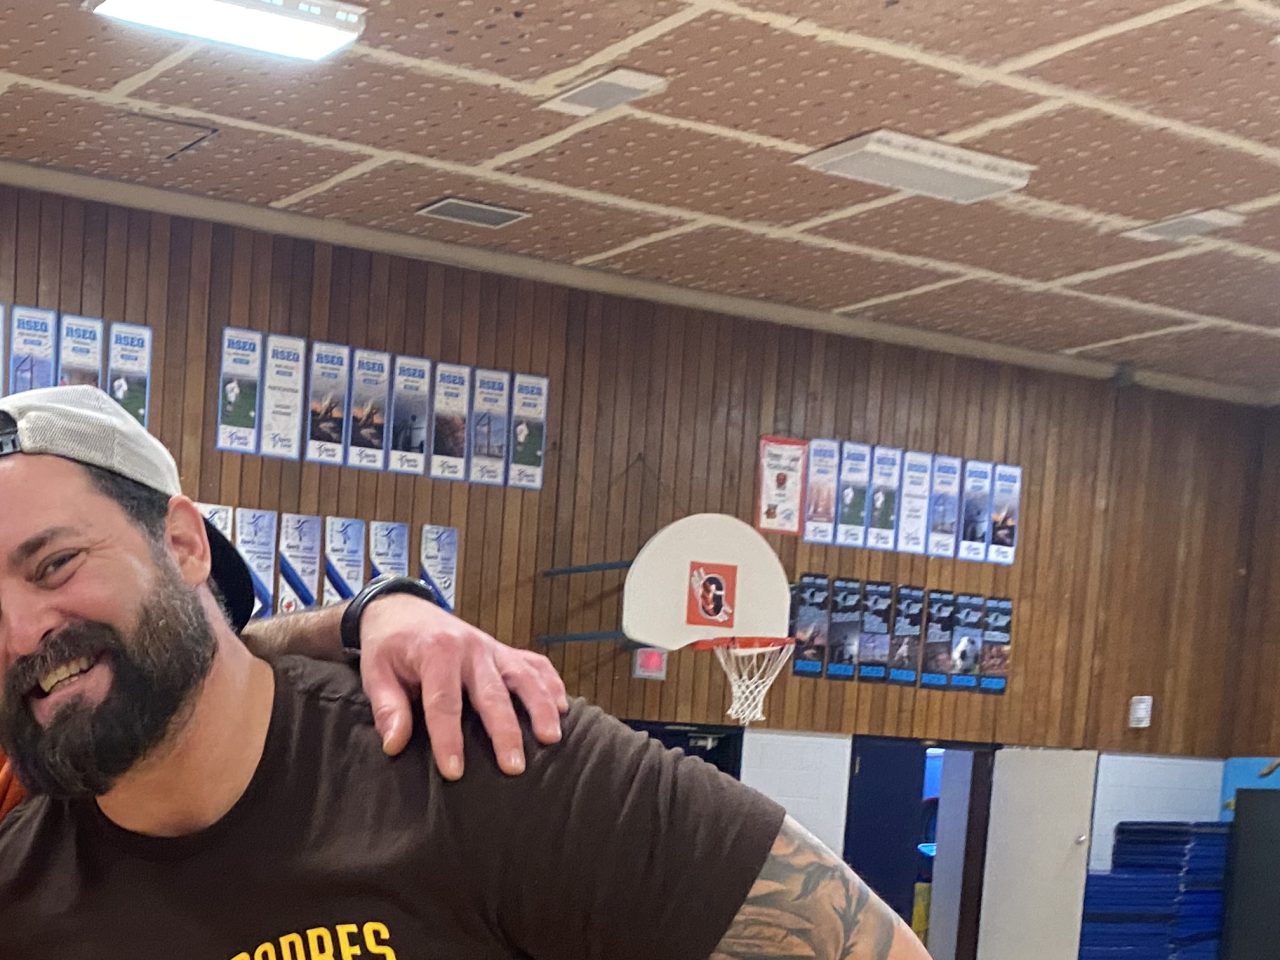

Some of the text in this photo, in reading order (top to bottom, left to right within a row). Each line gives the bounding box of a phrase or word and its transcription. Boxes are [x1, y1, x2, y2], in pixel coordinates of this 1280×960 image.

[16, 317, 49, 333] RSEQ
[65, 326, 98, 341] RSEQ
[114, 333, 145, 348] RSEQ
